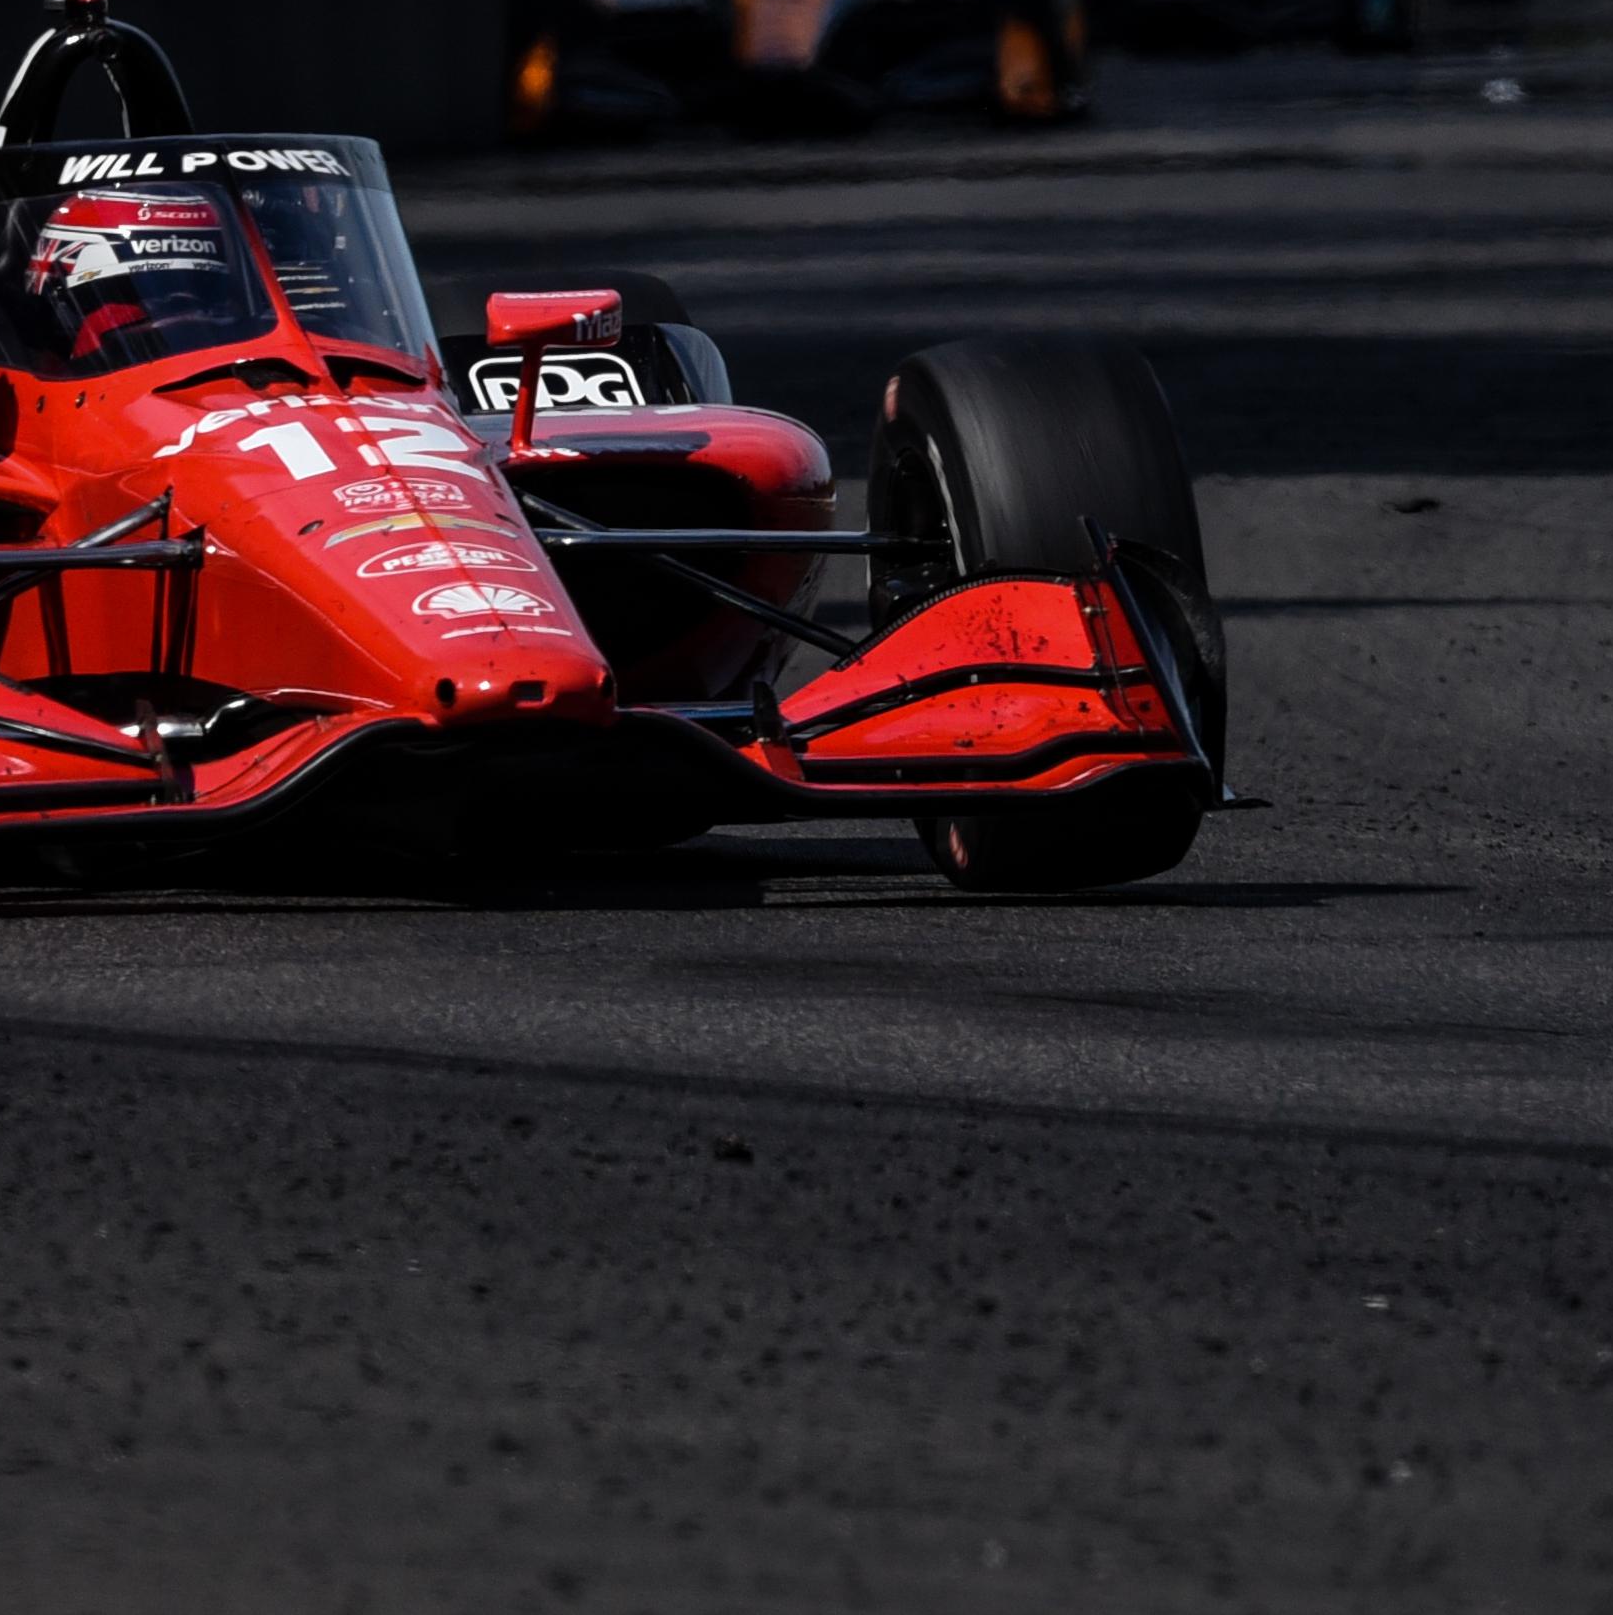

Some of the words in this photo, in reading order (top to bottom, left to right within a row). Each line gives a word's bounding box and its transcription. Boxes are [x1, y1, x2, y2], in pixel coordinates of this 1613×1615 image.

[58, 151, 164, 184] WILL
[181, 148, 350, 177] POWER
[130, 234, 218, 256] verizon
[238, 416, 489, 480] 12
